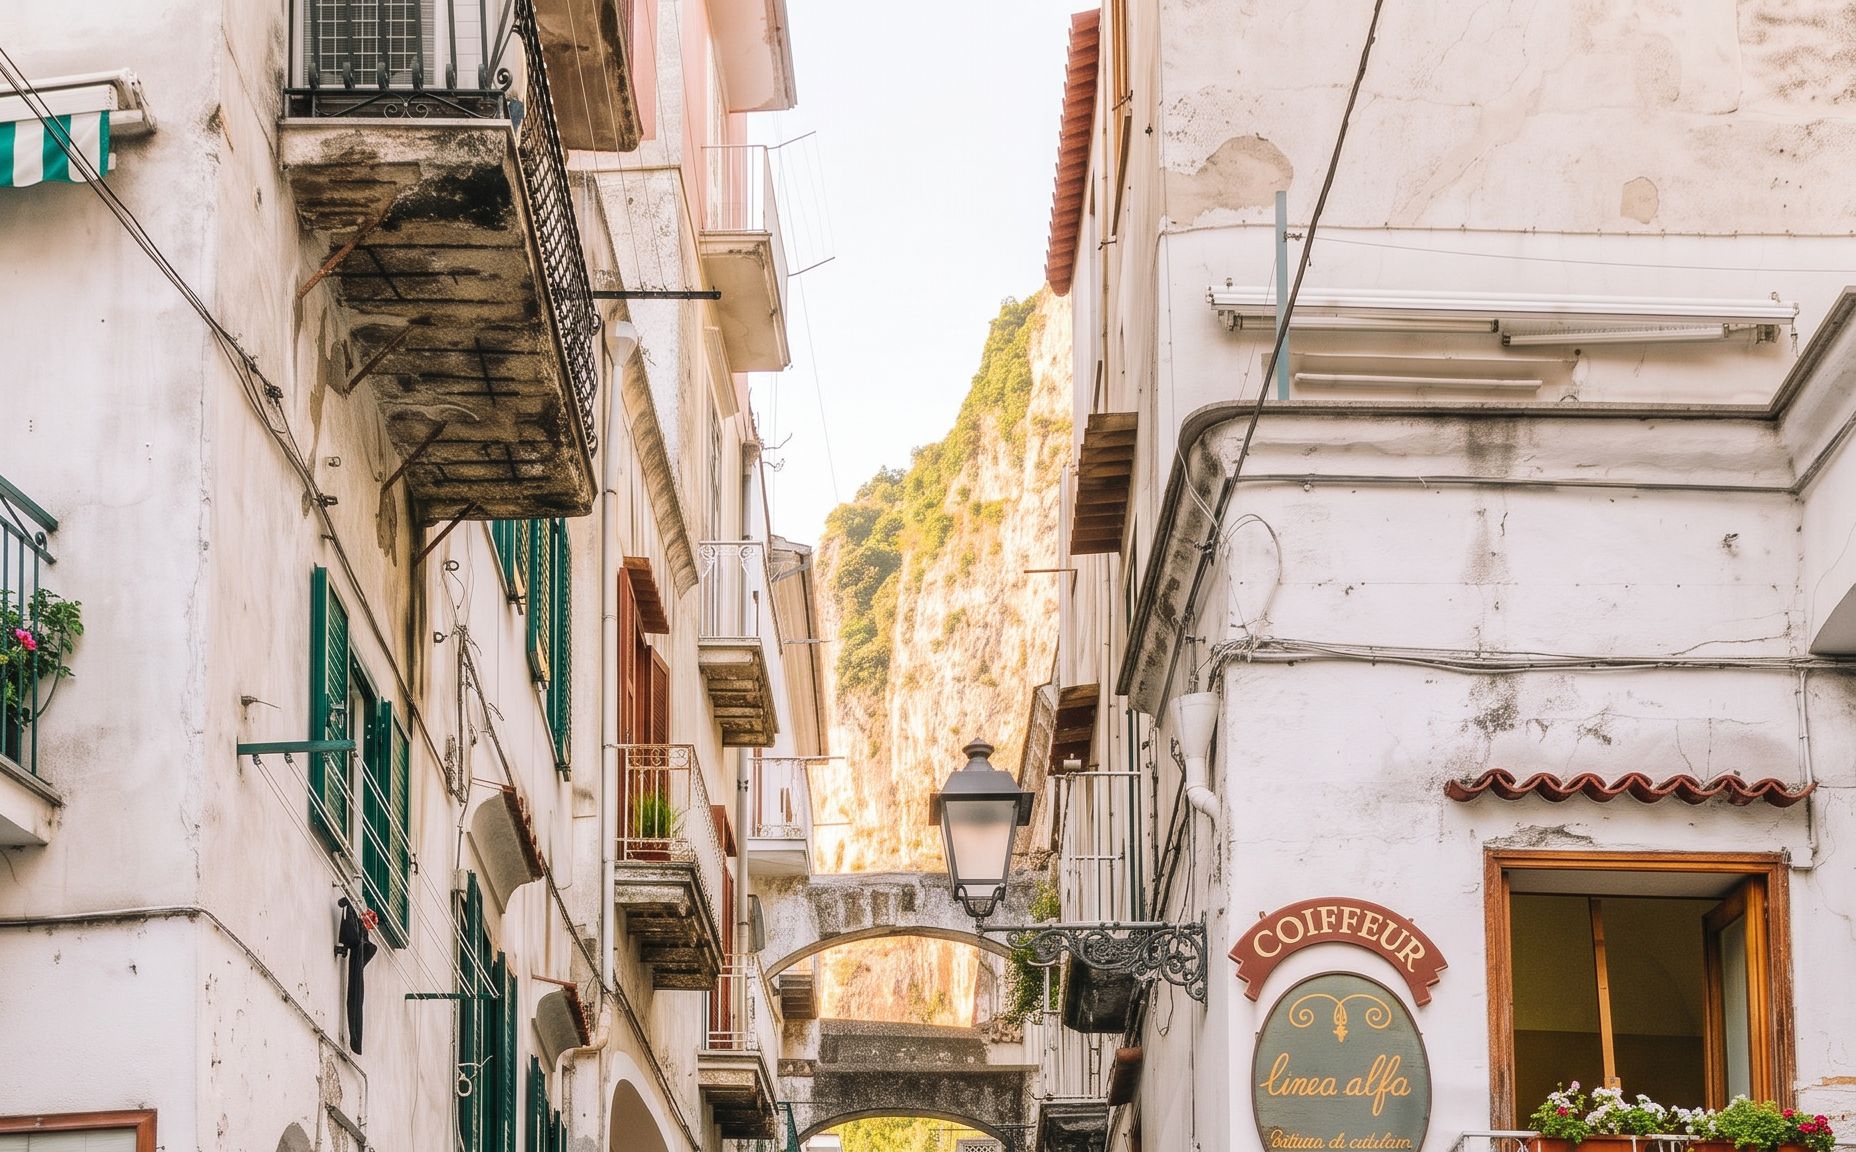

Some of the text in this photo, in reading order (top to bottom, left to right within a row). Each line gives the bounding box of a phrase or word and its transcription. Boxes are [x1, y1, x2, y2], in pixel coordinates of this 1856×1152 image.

[1253, 905, 1427, 974] COIFFEUR
[1259, 1052, 1412, 1117] linea alfa
